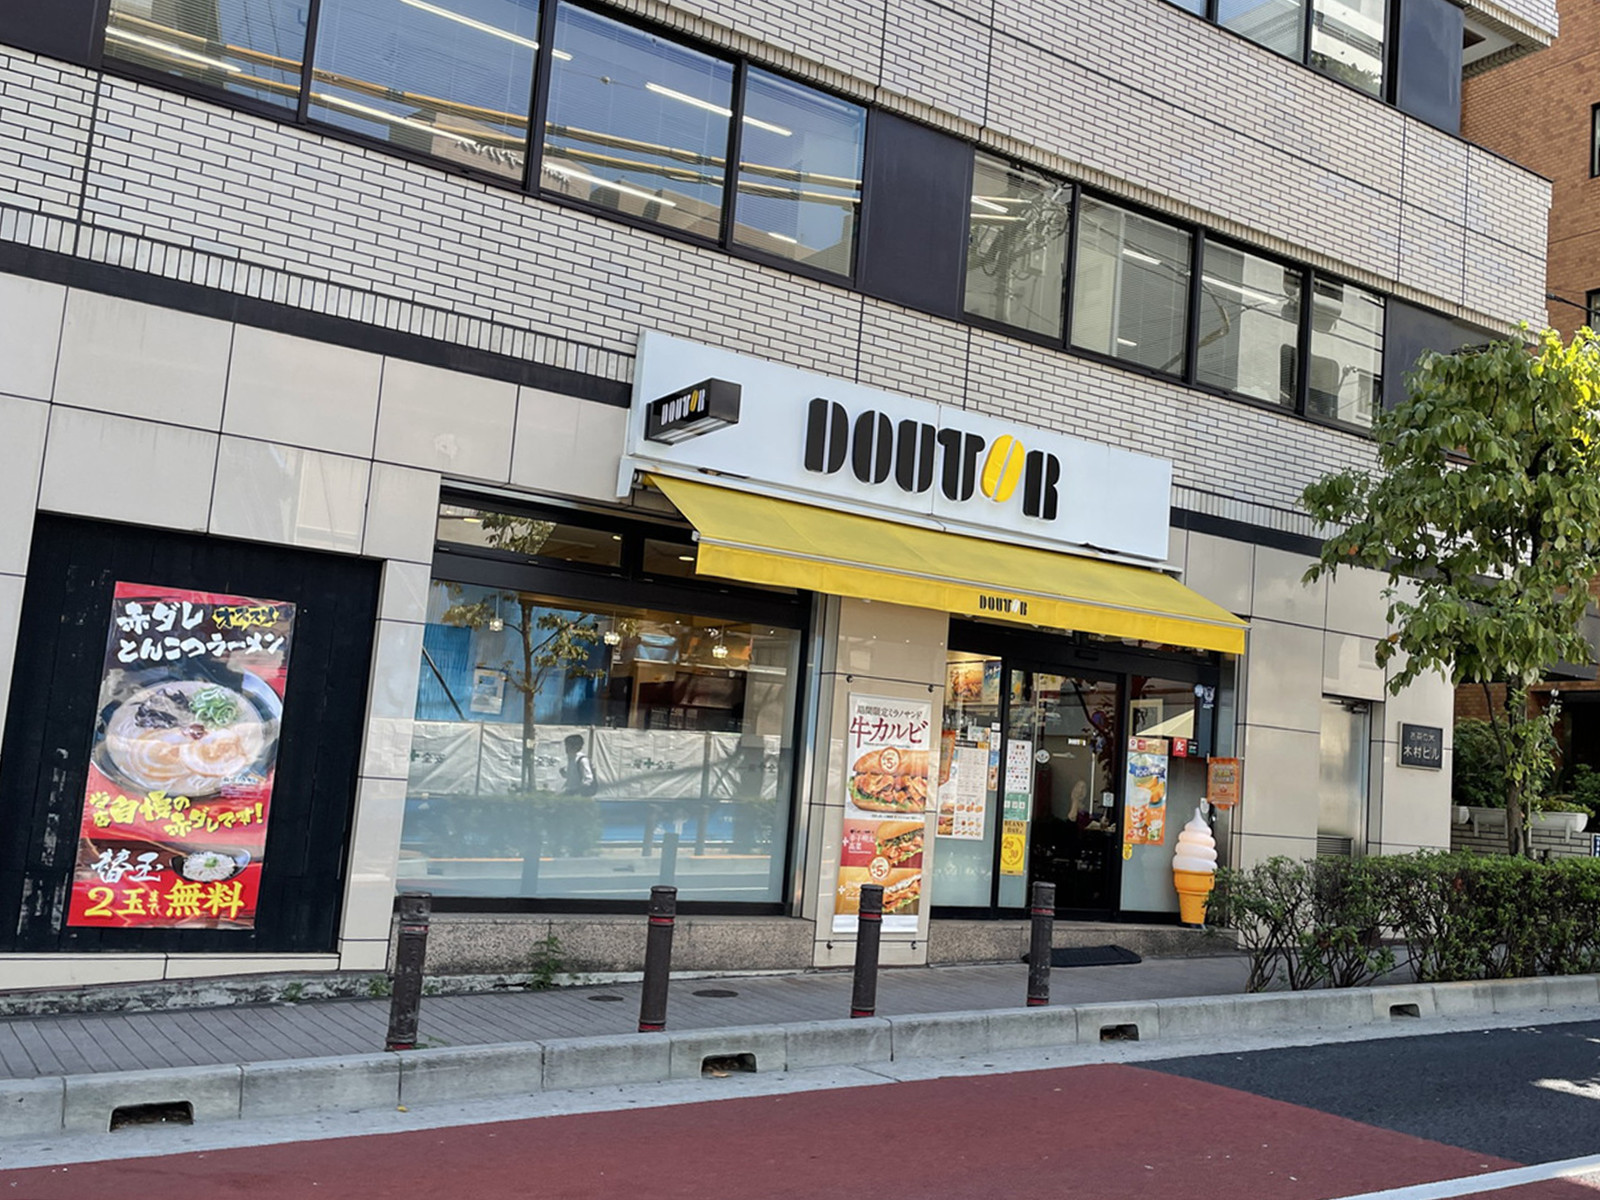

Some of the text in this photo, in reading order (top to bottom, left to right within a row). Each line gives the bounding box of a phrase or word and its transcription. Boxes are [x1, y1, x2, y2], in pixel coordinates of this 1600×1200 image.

[661, 389, 706, 426] DOUTOR
[804, 398, 1061, 521] DOUTOR
[979, 594, 1028, 616] DOUTOR
[117, 632, 285, 663] とんこつラーメン
[849, 715, 929, 748] 牛カルビ
[1403, 745, 1440, 760] 木村ビル
[91, 848, 165, 883] 替玉
